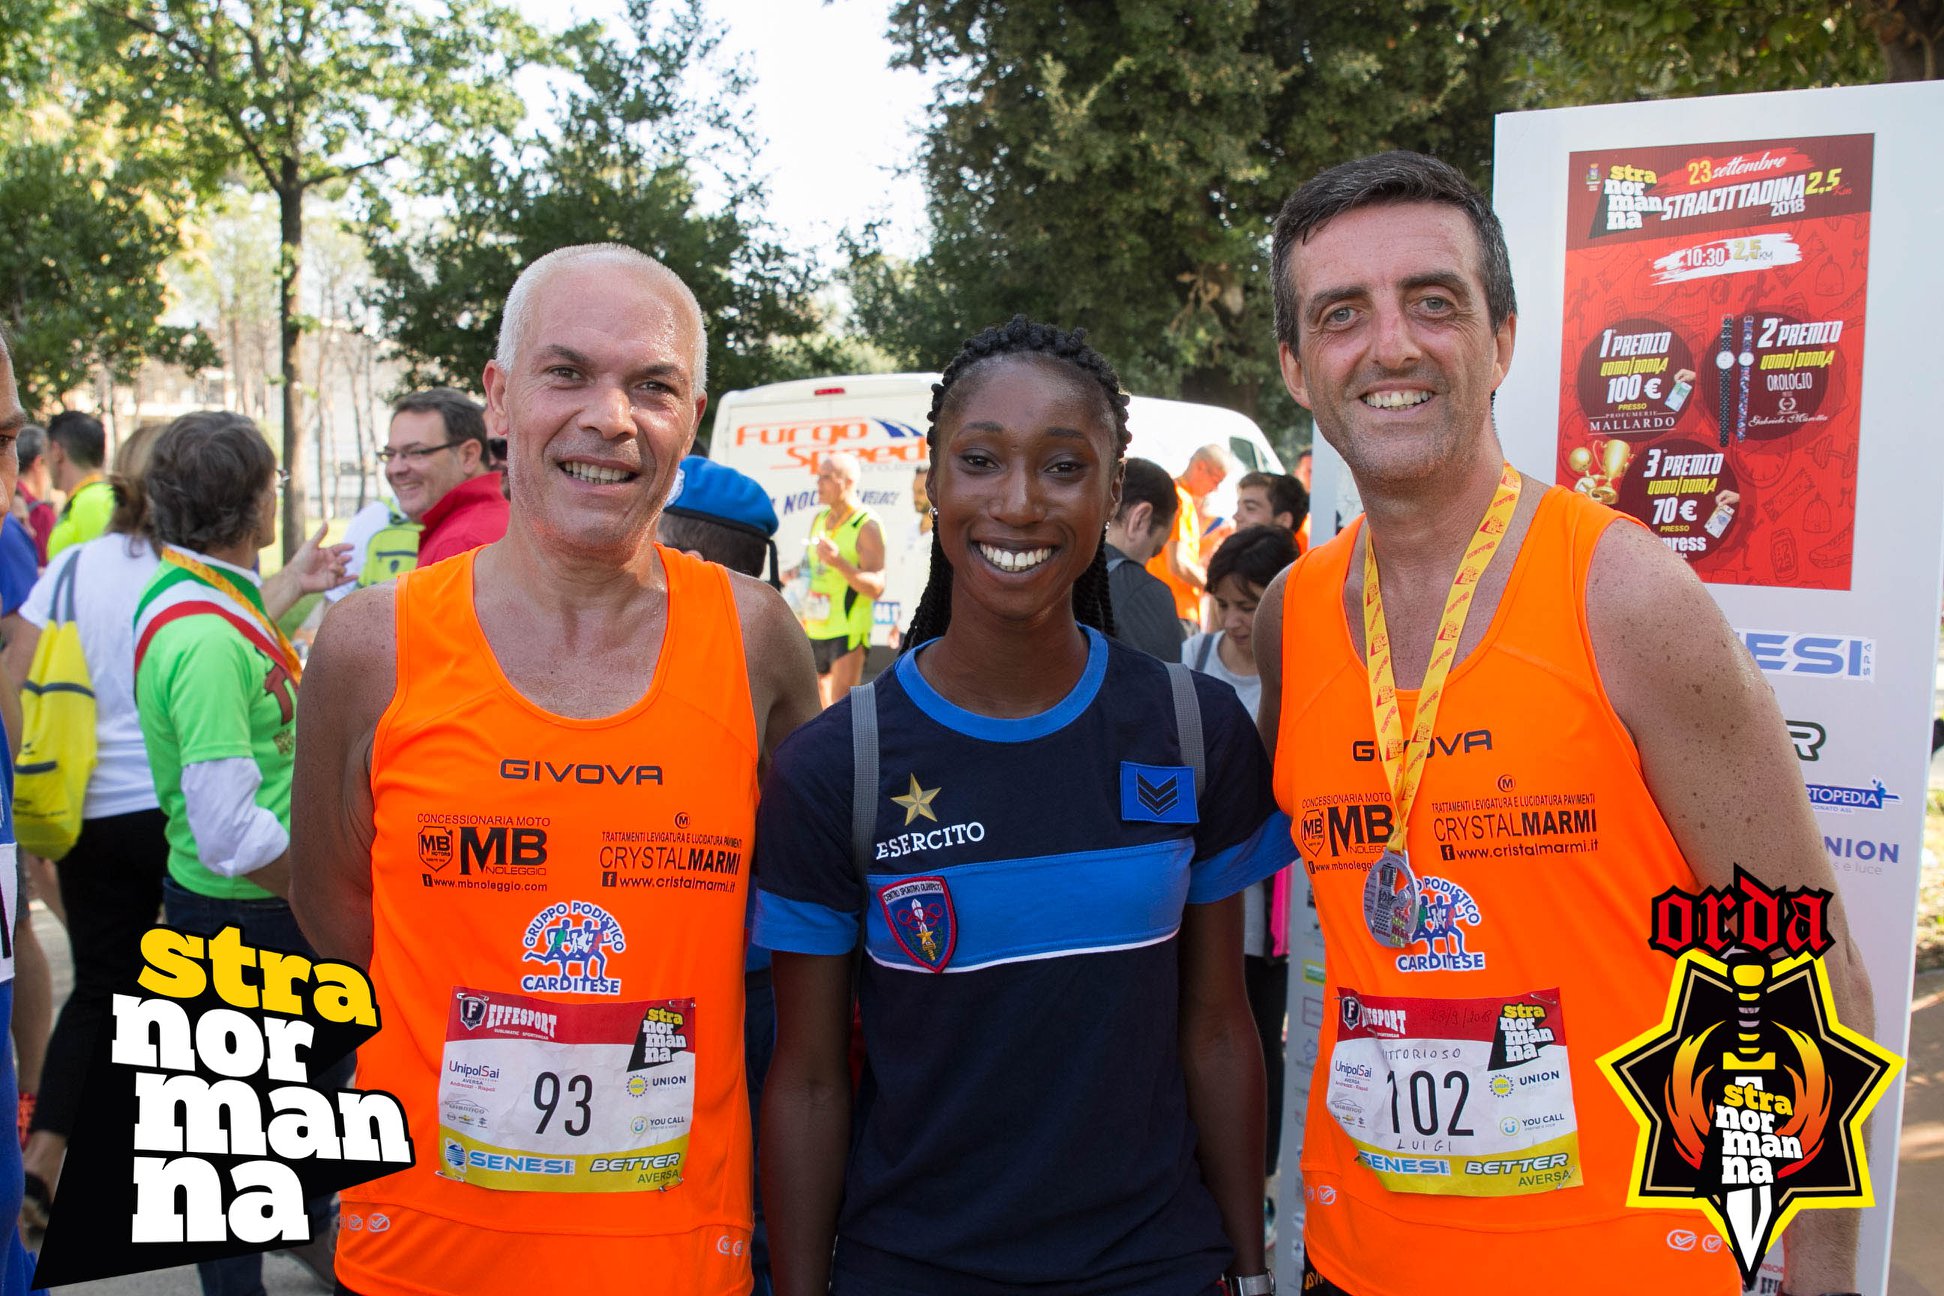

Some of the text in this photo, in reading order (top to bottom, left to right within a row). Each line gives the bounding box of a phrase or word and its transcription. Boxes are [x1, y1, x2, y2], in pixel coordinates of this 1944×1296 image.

[1610, 164, 1658, 184] stra
[1687, 151, 1787, 185] 23 settembre
[1604, 178, 1646, 196] nor
[1608, 194, 1663, 212] man
[1661, 174, 1806, 221] STRACITTADINA
[1770, 198, 1806, 217] 2018
[1606, 210, 1643, 231] na
[1685, 246, 1726, 268] 10:30
[1733, 239, 1762, 261] 2,5
[1776, 320, 1844, 347] PREMIO
[1611, 331, 1672, 357] PREMIO
[1607, 374, 1662, 404] 100 €
[1767, 372, 1813, 392] OROLOGIO
[1618, 402, 1647, 411] PRESSO
[1590, 416, 1676, 432] MALLARDO
[1661, 453, 1724, 477] PREMIO
[1652, 496, 1698, 525] 70 €
[1660, 525, 1690, 533] PRESSO
[1737, 632, 1863, 677] ESI
[499, 758, 664, 786] GIVOVA
[1301, 792, 1392, 809] CONCESSIONARIA MOTO
[1431, 793, 1595, 813] TRATTAMENTI LEVIGATURA E LUCIDATURA PAVIMENTI
[1806, 787, 1880, 807] RTOPEDIA
[417, 813, 551, 827] CONCESSIONARIA MOTO
[1303, 818, 1323, 841] MB
[1433, 808, 1598, 842] CRYSTALMARMI
[602, 831, 646, 842] TRATTAMENTI
[646, 832, 686, 843] LEVIGATURA
[1326, 804, 1395, 857] MB
[420, 834, 451, 855] MB
[459, 826, 548, 876] MB
[876, 822, 985, 860] ESERCITO
[1456, 838, 1599, 860] www.cristalmarmi.it
[1823, 835, 1900, 864] NION
[599, 845, 742, 876] CRYSTALMARMI
[485, 866, 547, 876] NOLEGGIO
[433, 878, 548, 892] www.mbnoleggio.com
[620, 876, 736, 893] www.cristalmarmi.it
[1424, 877, 1481, 924] PODISTICO
[524, 901, 625, 952] GRUPPO PODISTICO
[1397, 953, 1484, 971] CARDITESE
[522, 976, 621, 994] CARDITESE
[647, 1008, 684, 1026] stra
[1503, 1002, 1546, 1019] stra
[486, 1003, 558, 1039] EFFESPORT
[642, 1019, 675, 1035] nor
[1499, 1015, 1536, 1032] nor
[645, 1032, 687, 1048] man
[1504, 1027, 1556, 1046] man
[643, 1046, 672, 1064] na
[1505, 1043, 1539, 1062] na
[448, 1060, 500, 1080] UnipolSai
[1335, 1060, 1372, 1079] UnipolSai
[1519, 1070, 1561, 1086] UNION
[651, 1075, 688, 1087] UNION
[533, 1071, 594, 1137] 93
[1387, 1070, 1474, 1137] 102
[650, 1115, 685, 1127] YOU CALL
[1522, 1113, 1565, 1127] YOU CALL
[1396, 1139, 1452, 1152] LUIGI
[469, 1150, 571, 1174] SENESI
[589, 1152, 681, 1173] BETTER
[1359, 1150, 1447, 1174] SENESI
[1465, 1152, 1569, 1175] BETTER
[637, 1169, 680, 1184] AVERSA
[1518, 1169, 1572, 1187] AVERSA
